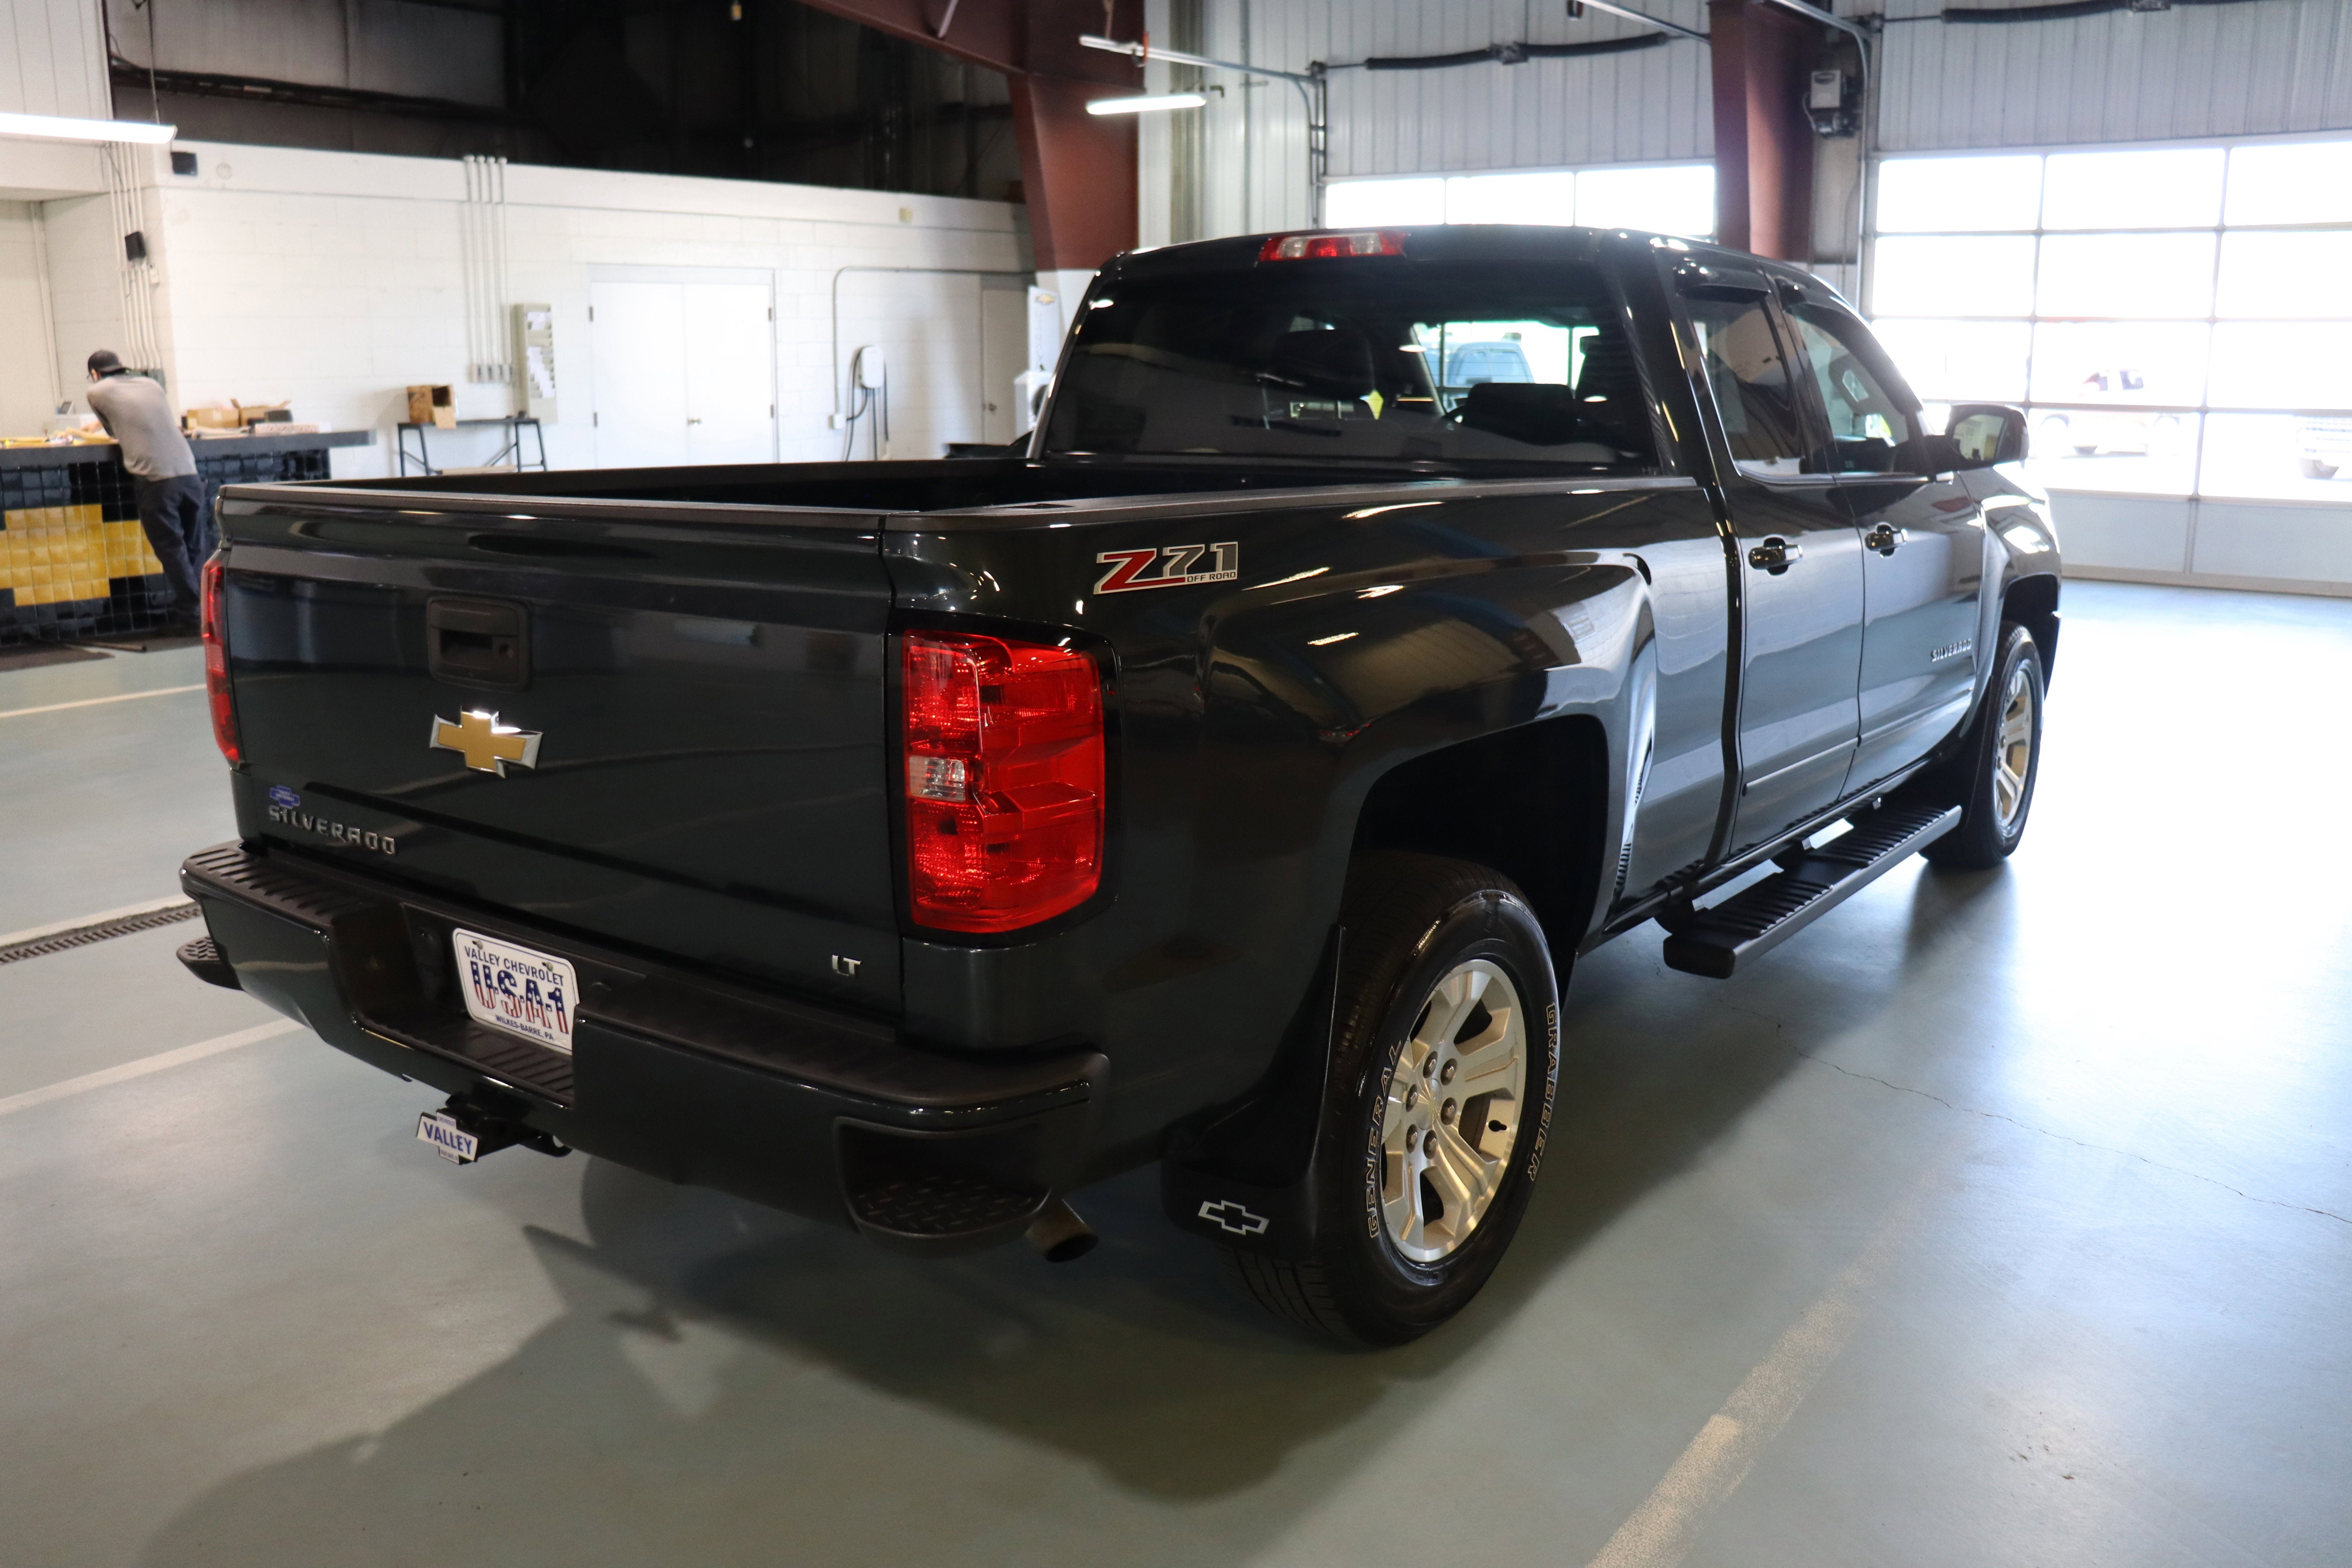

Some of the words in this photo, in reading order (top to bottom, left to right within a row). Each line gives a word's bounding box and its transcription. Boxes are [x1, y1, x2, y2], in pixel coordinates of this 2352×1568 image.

[1093, 541, 1238, 595] Z71
[1209, 571, 1236, 580] ROAD
[1931, 638, 1971, 662] SILVERADO
[269, 805, 396, 855] SILVERADO
[465, 946, 500, 967] VALLEY
[504, 958, 564, 986] CHEVROLET
[832, 955, 862, 976] LT
[545, 1031, 554, 1040] PA
[1528, 1003, 1558, 1181] GRABBER
[423, 1121, 472, 1155] VALLEY
[1366, 1040, 1401, 1238] GENERAL
